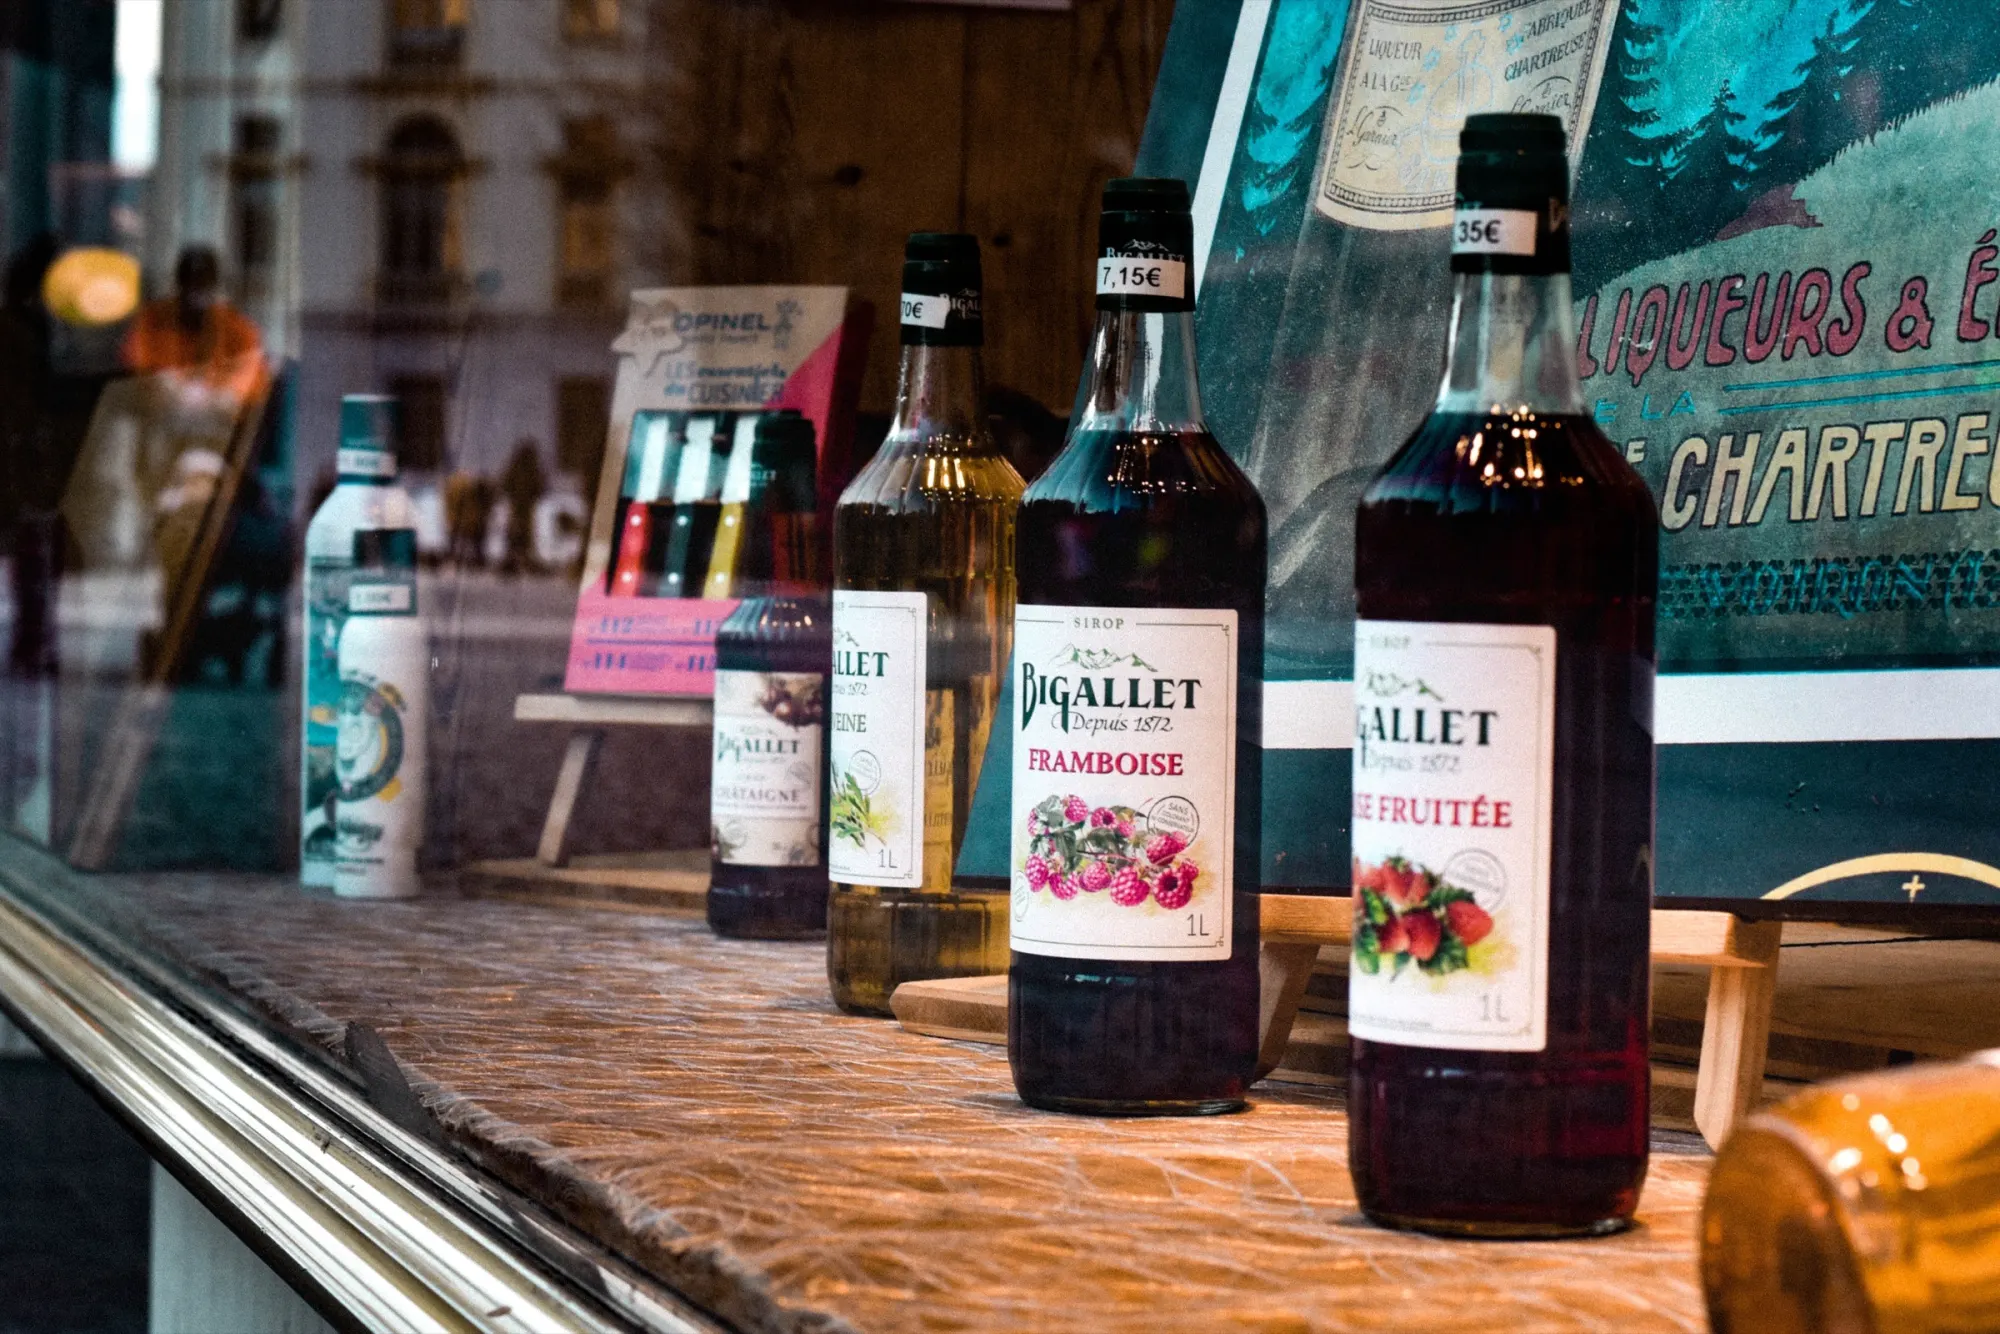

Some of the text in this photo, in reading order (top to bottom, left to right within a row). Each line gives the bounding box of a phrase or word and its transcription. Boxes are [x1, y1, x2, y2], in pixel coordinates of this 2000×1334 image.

[1368, 38, 1423, 60] LIQUEUR
[1503, 31, 1587, 82] CHARTREUSE
[1103, 266, 1161, 288] 7,15€
[674, 312, 770, 333] OPINEL
[1576, 260, 1873, 388] LIQUEURS
[1884, 276, 1935, 354] &
[1640, 389, 1697, 421] LA
[1074, 618, 1125, 630] SIROP
[1022, 662, 1202, 734] BIGALLET
[1052, 711, 1174, 737] Depuis 1872
[1028, 748, 1185, 777] FRAMBOISE
[1378, 794, 1513, 829] FRUITÉE
